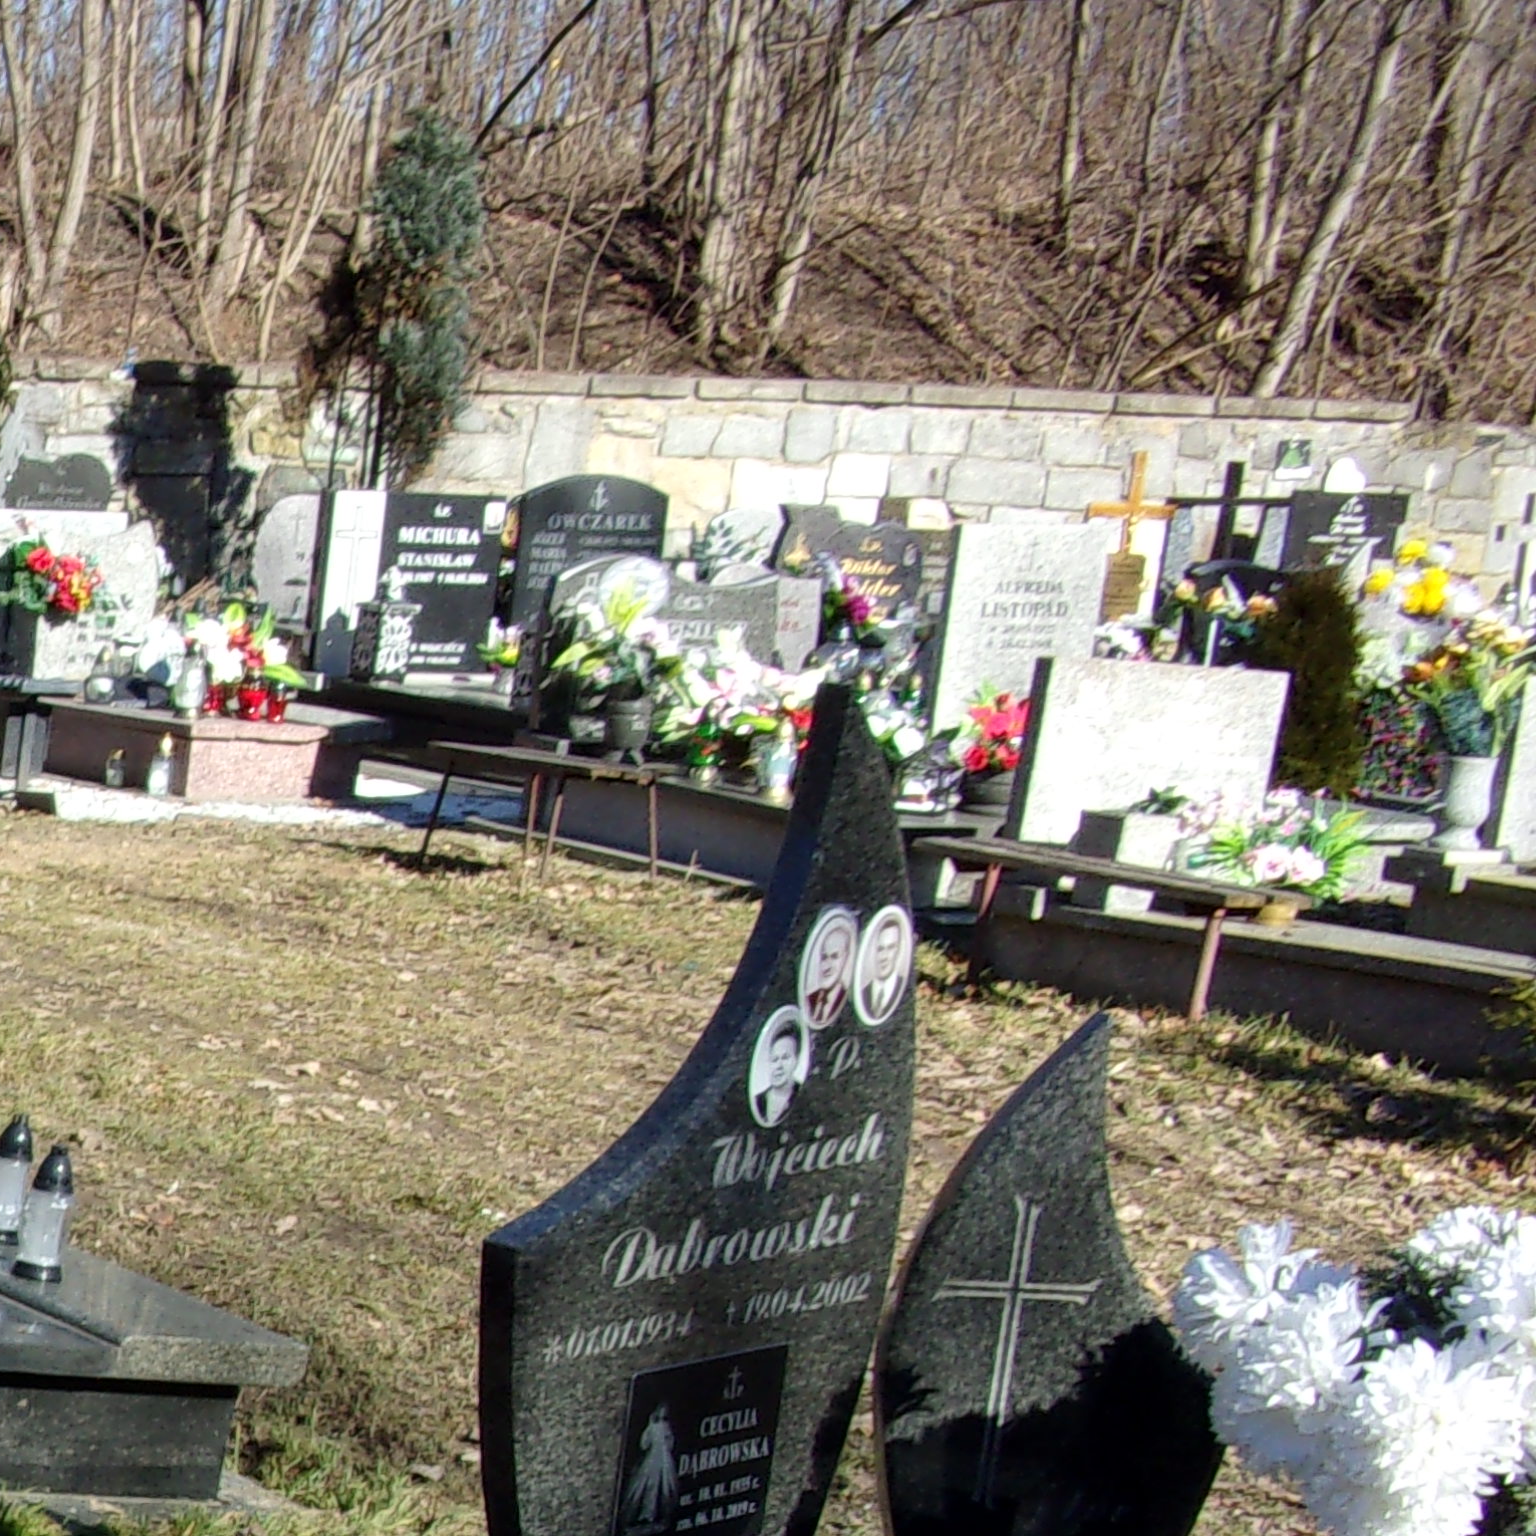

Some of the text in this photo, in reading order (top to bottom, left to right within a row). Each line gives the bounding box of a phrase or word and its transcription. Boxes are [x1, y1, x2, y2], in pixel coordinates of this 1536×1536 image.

[397, 526, 481, 545] MICHURA
[710, 1112, 885, 1191] Wojciech
[600, 1193, 861, 1288] Dąbrowski
[699, 1407, 759, 1439] CECYLIA
[677, 1435, 770, 1479] DĄBROWSKA
